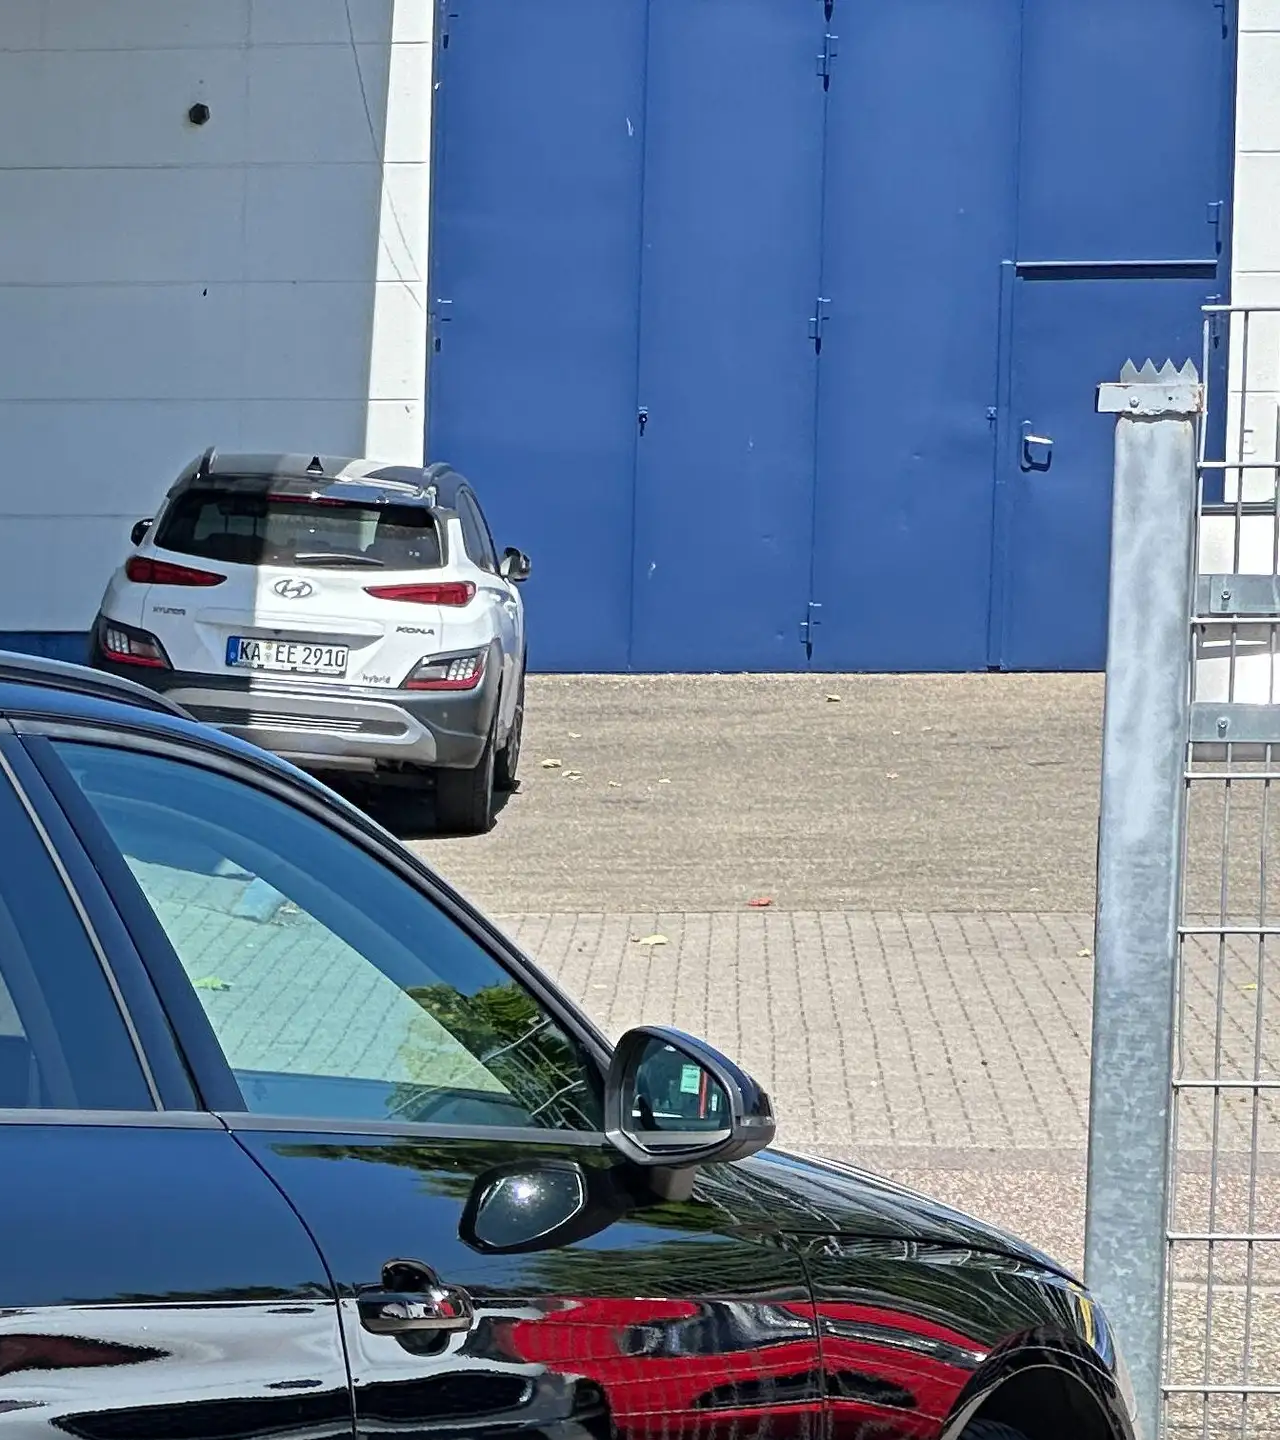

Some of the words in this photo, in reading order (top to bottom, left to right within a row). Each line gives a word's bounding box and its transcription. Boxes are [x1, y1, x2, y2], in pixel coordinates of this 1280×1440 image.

[396, 625, 435, 636] KONA
[239, 641, 261, 661] KA
[275, 644, 297, 664] EE
[301, 646, 346, 668] 2910
